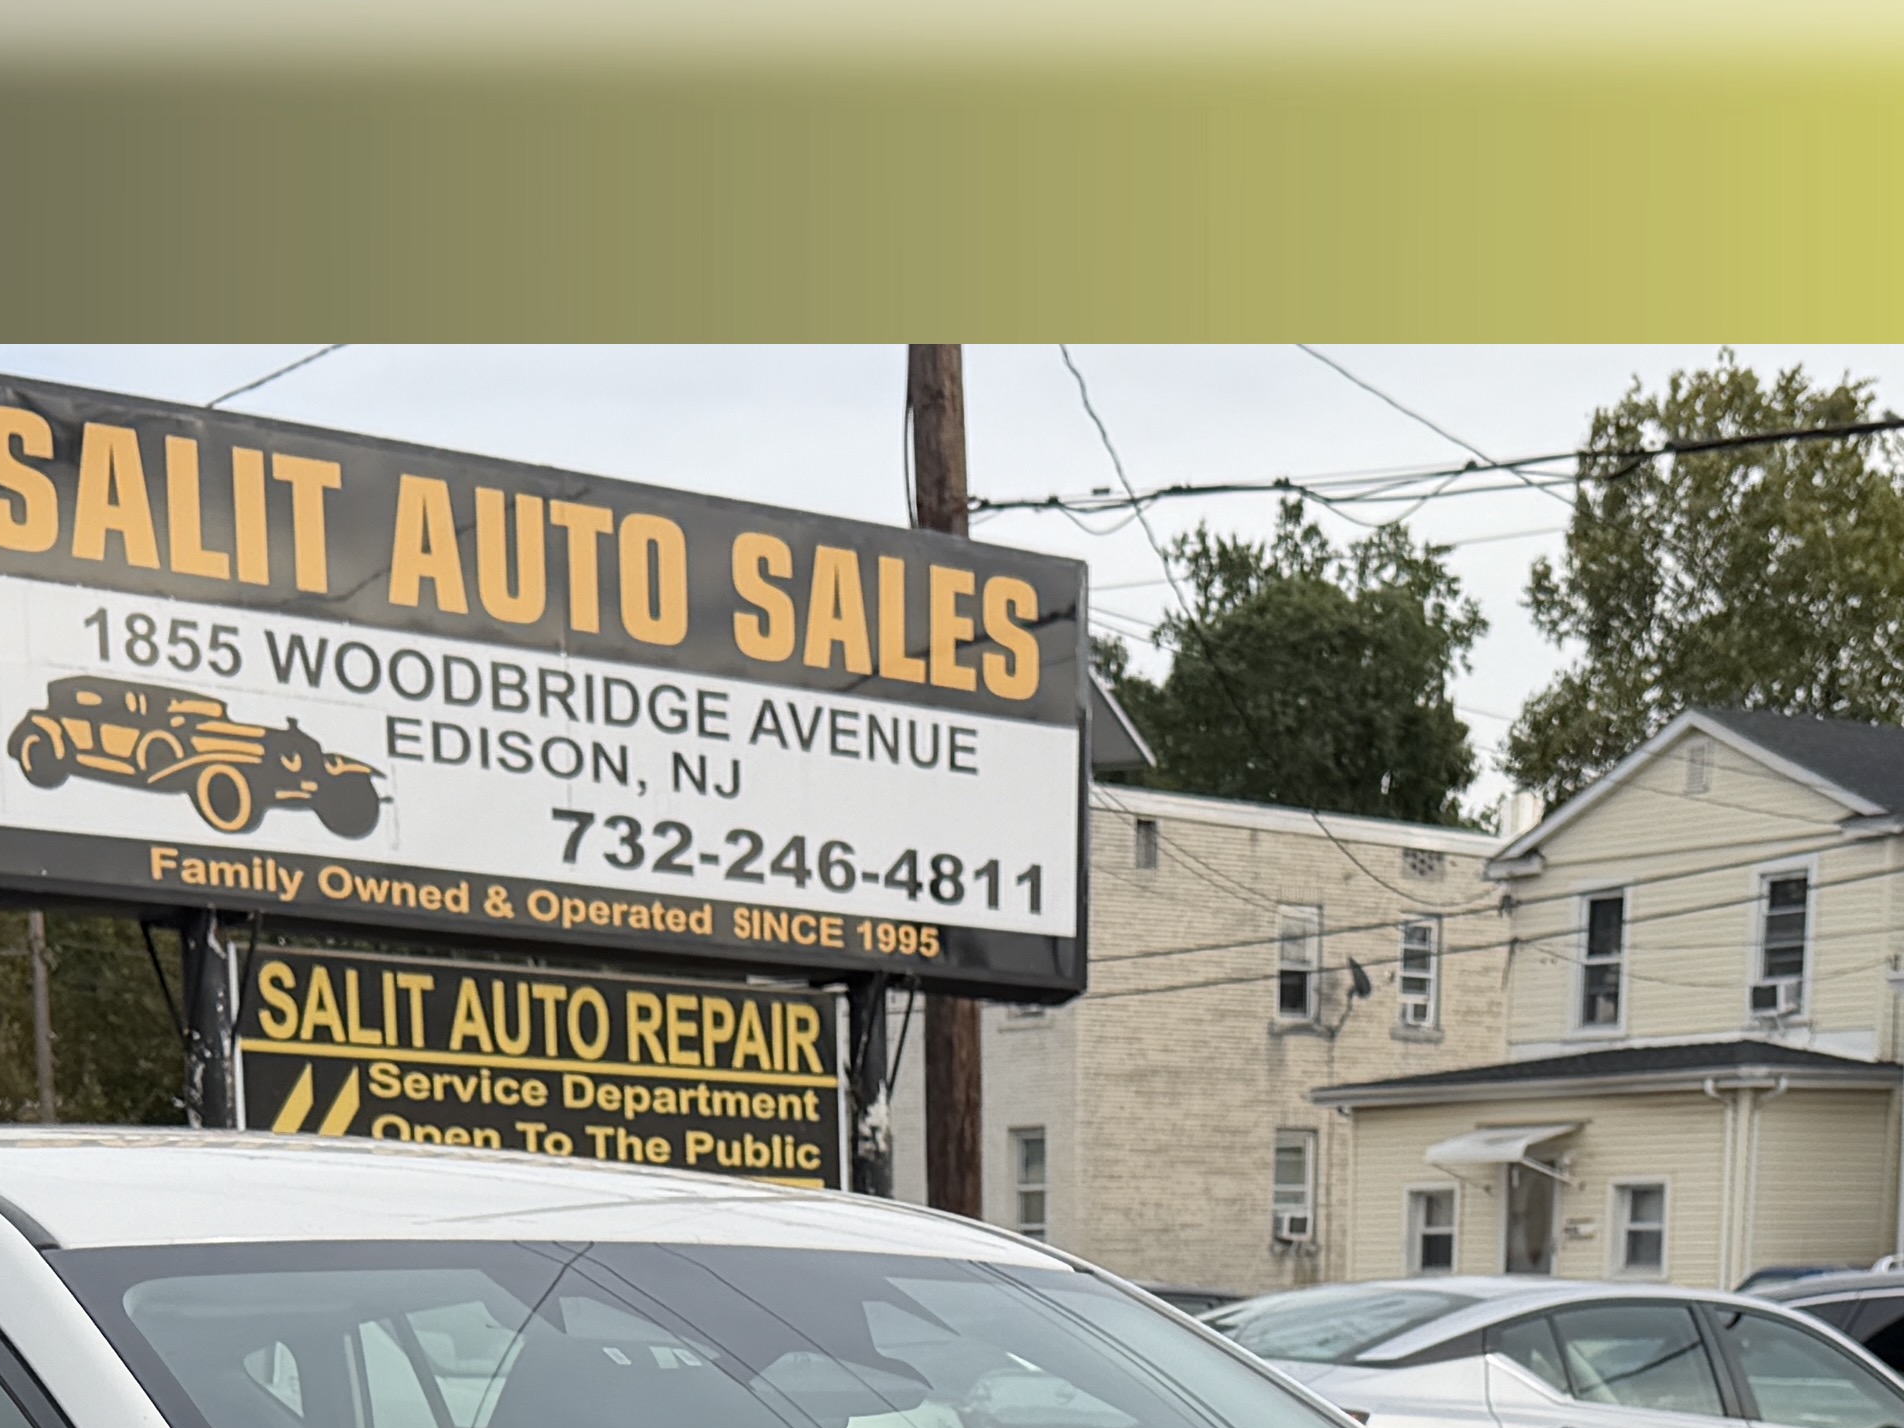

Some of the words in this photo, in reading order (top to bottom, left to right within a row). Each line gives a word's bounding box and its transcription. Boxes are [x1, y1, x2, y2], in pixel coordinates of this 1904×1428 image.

[390, 476, 688, 645] AUTO
[734, 532, 1039, 700] SALES
[84, 608, 241, 678] 1855
[265, 631, 730, 741] WOODBRIDGE
[750, 699, 979, 775] AVENUE
[386, 716, 646, 792] EDISON,
[672, 752, 741, 799] NJ
[151, 847, 304, 902] Family
[319, 865, 471, 914] Owned
[484, 885, 515, 919] &
[527, 889, 714, 936] Operated
[734, 907, 844, 949] SINCE
[857, 920, 940, 958] 1995
[551, 807, 1043, 915] 732-246-4811
[257, 960, 435, 1048] SALIT
[449, 978, 610, 1060] AUTO
[627, 991, 823, 1075] REPAIR
[368, 1062, 549, 1107] Service
[563, 1073, 820, 1122] Department
[515, 1121, 574, 1157] To
[585, 1125, 672, 1164] The
[686, 1130, 822, 1170] Public
